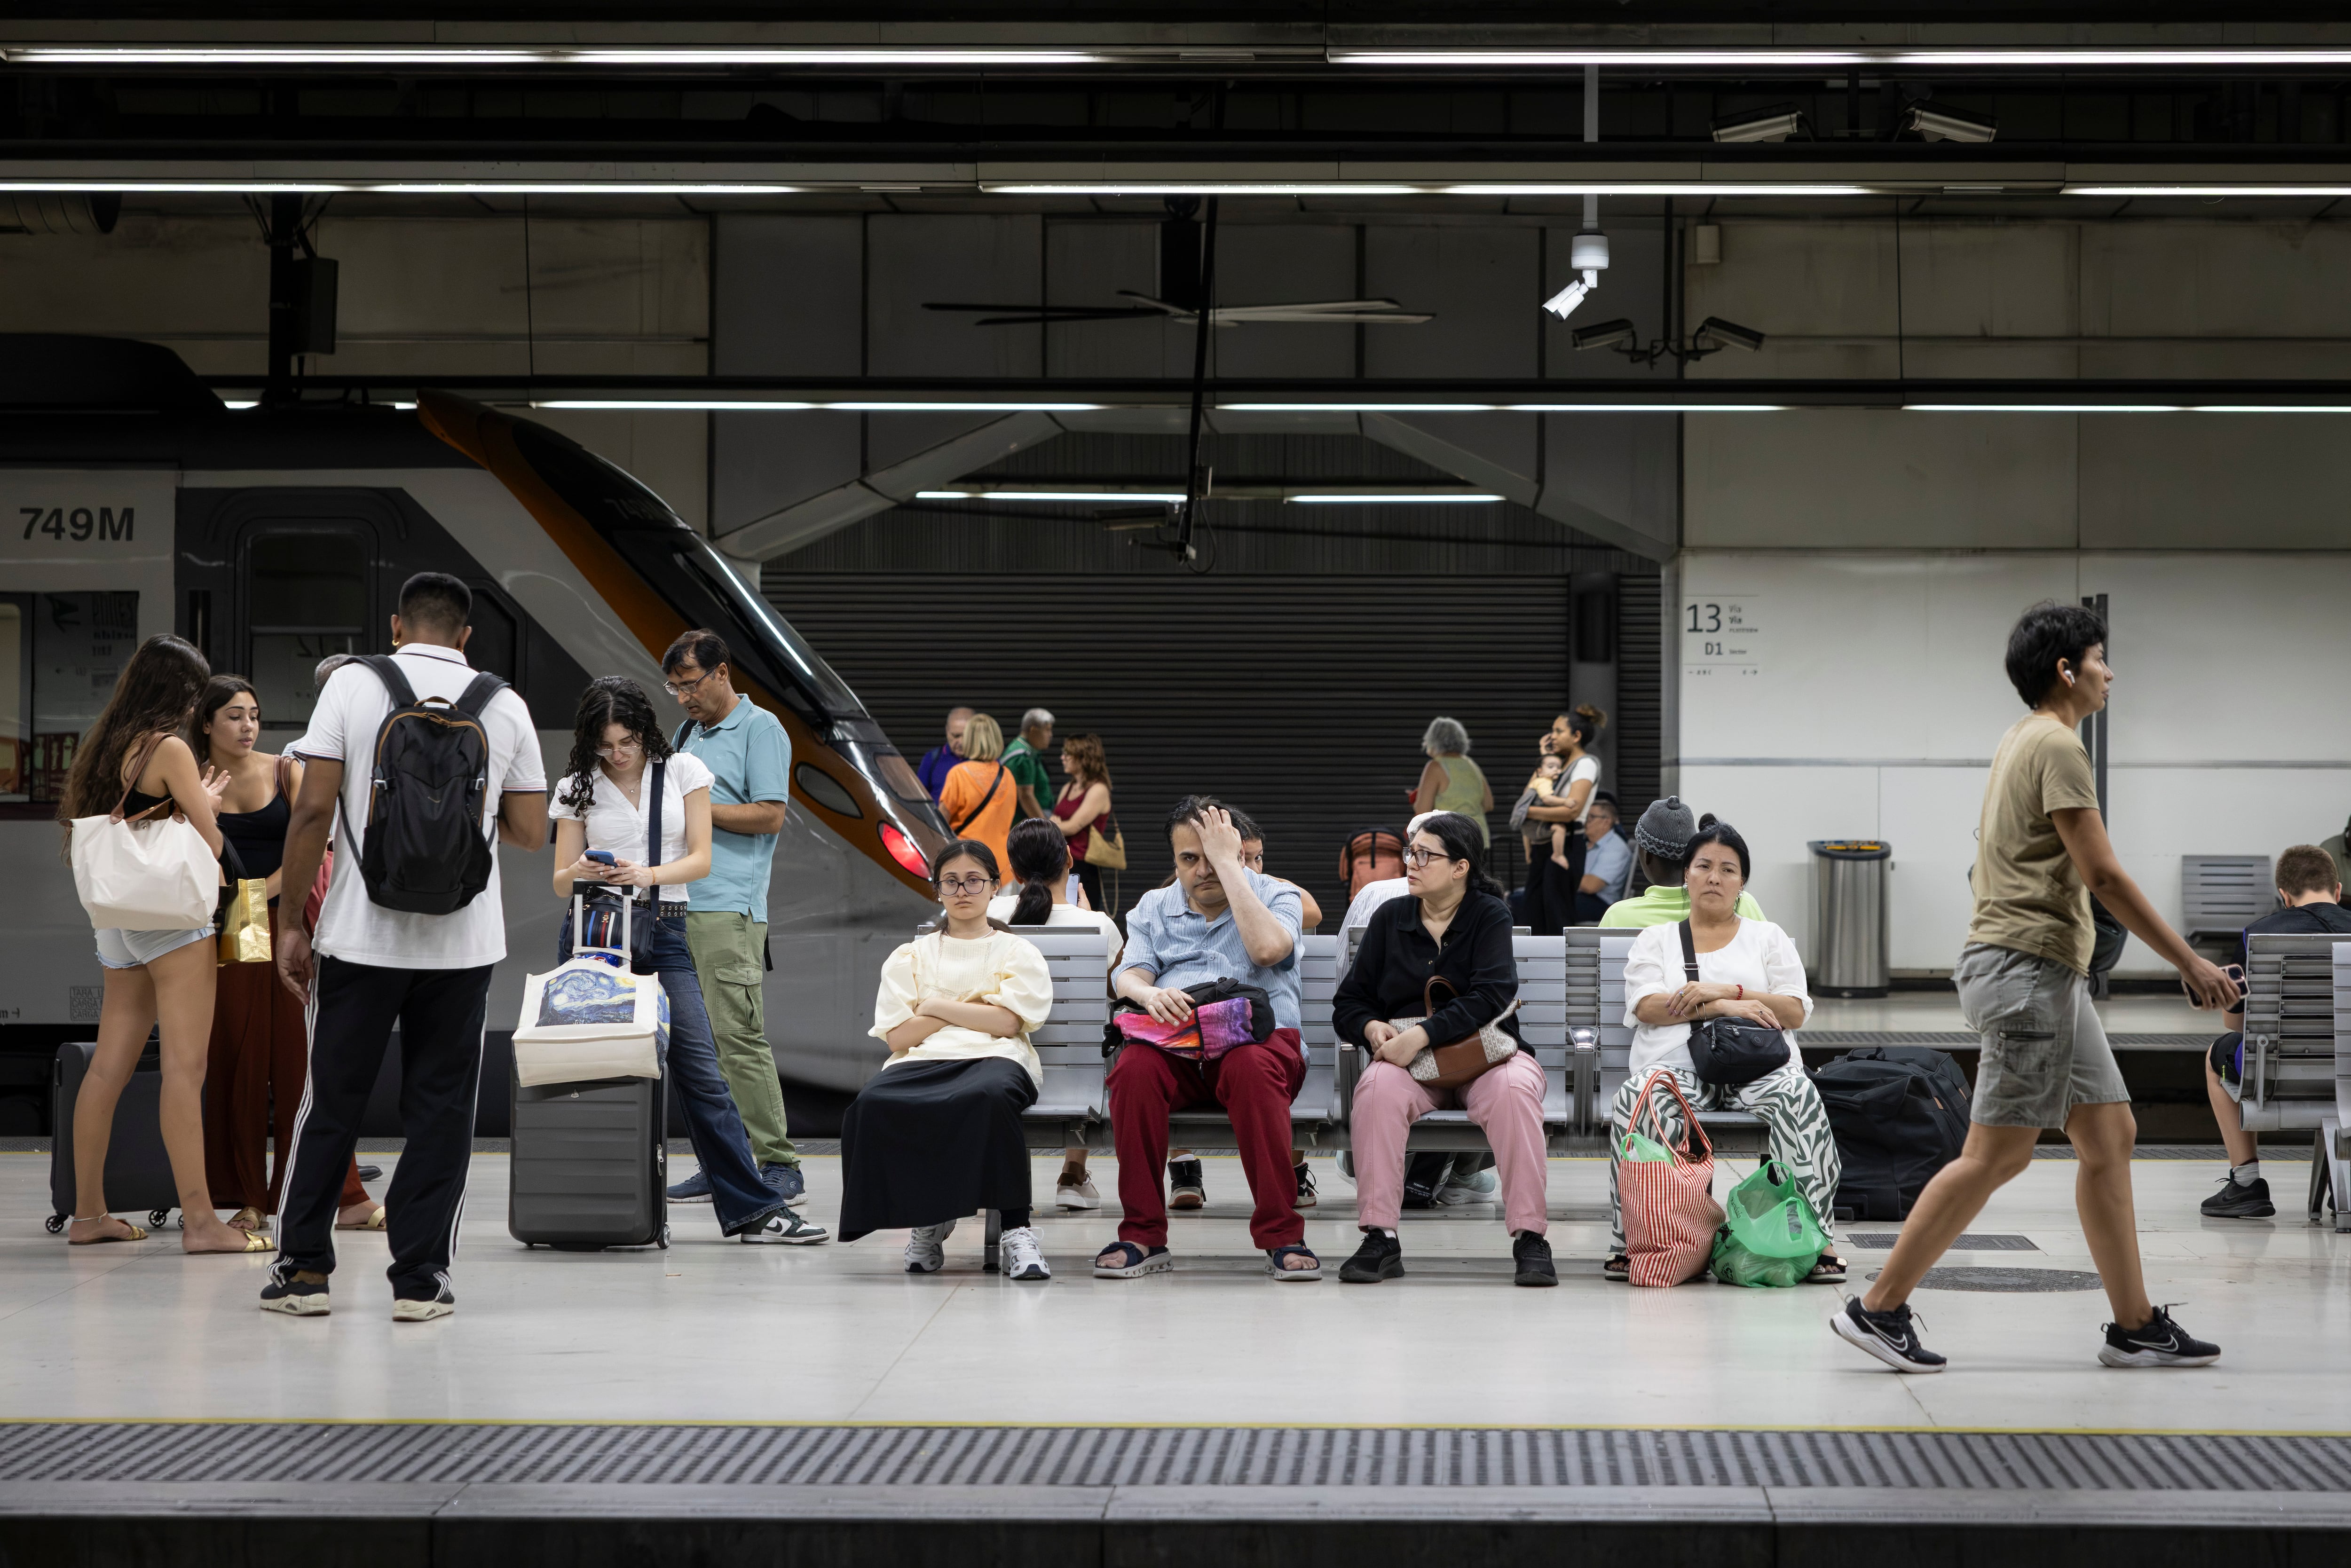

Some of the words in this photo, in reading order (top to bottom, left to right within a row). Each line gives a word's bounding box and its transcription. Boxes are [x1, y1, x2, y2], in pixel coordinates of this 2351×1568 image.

[20, 507, 134, 541] 749M
[1687, 604, 1721, 632] 13
[1705, 642, 1723, 655] D1
[72, 988, 93, 997] TARA
[72, 999, 98, 1009] CARGA
[72, 1010, 98, 1019] CARGA
